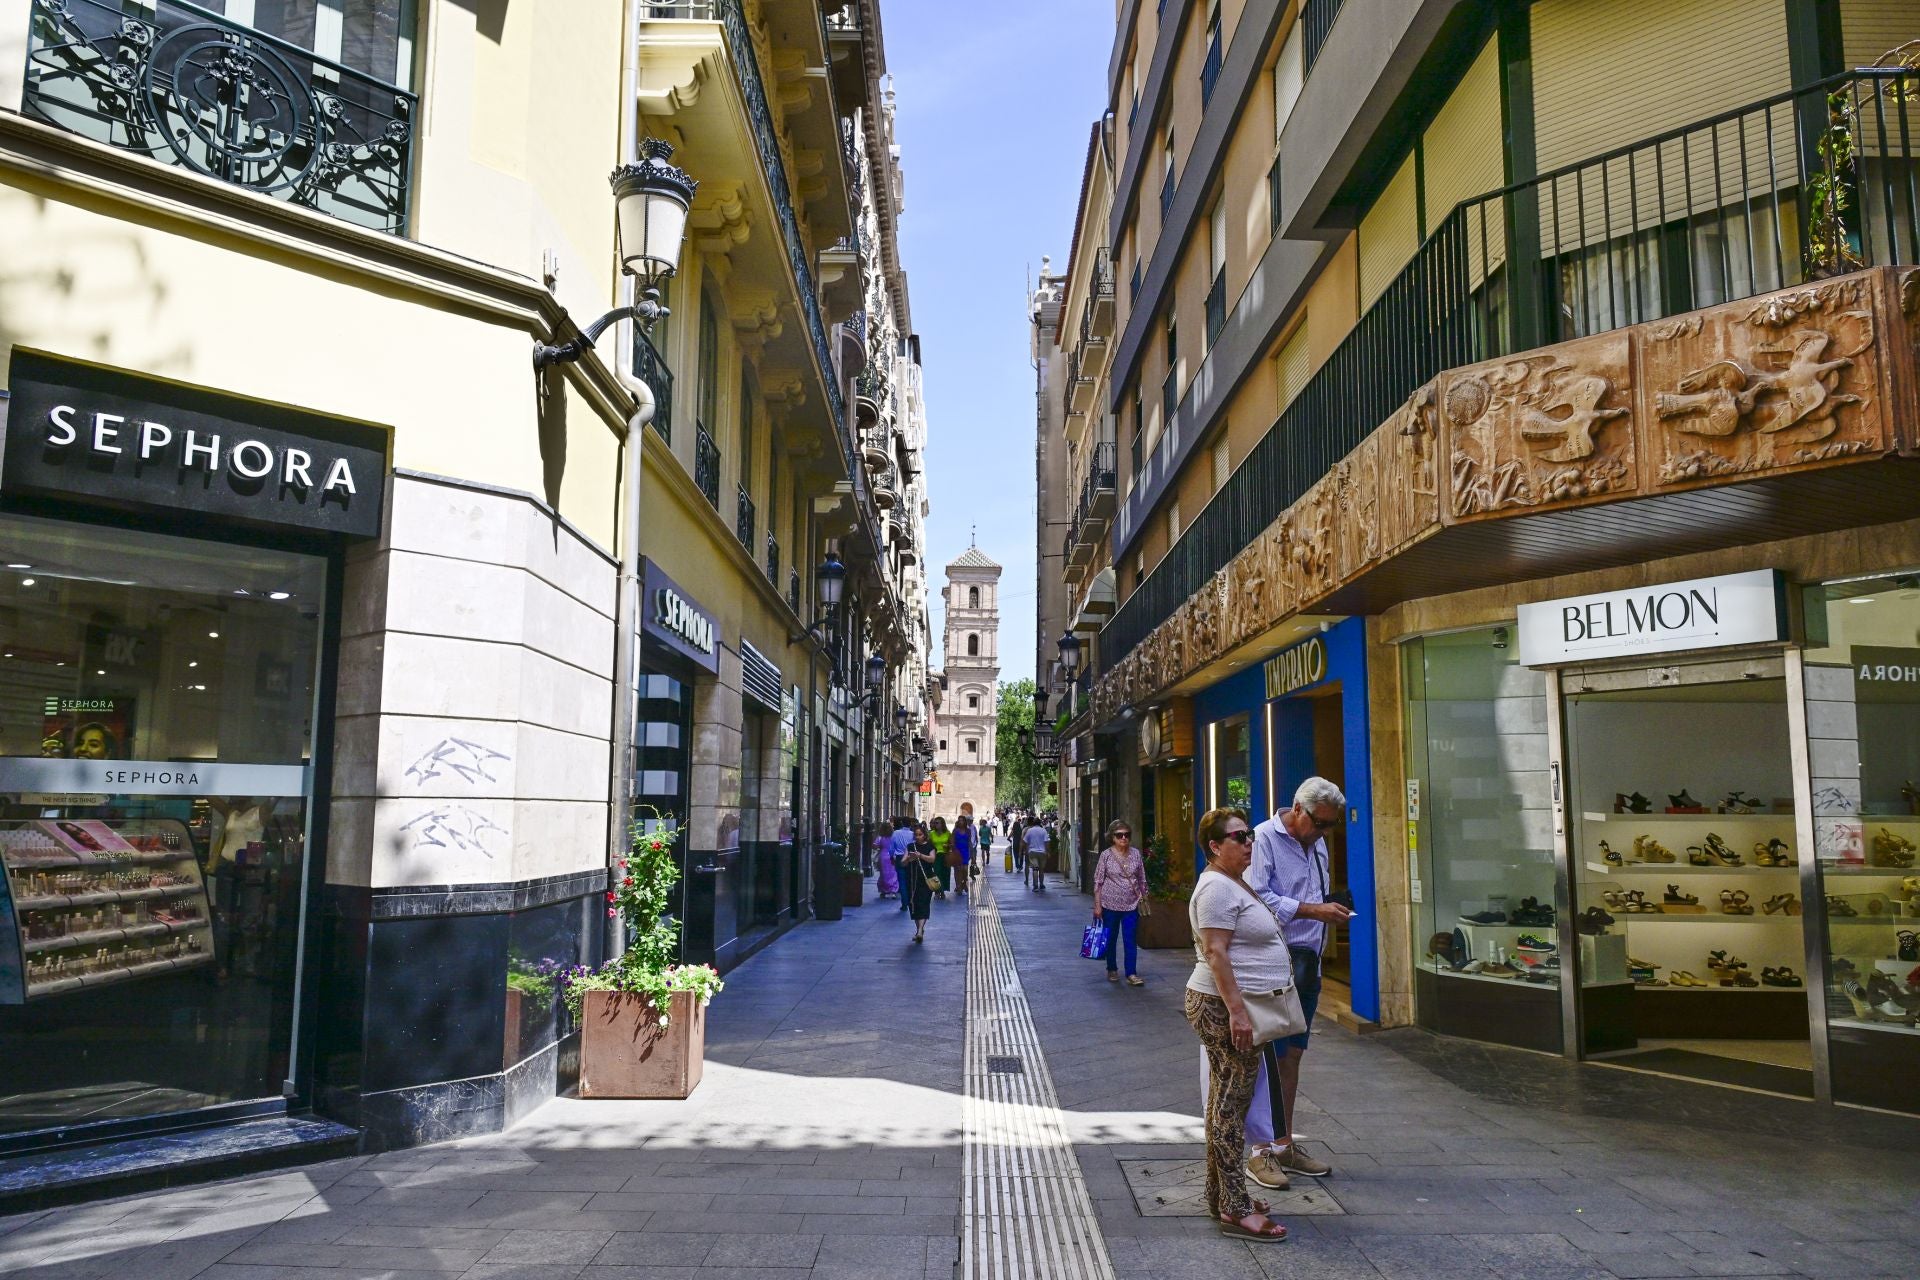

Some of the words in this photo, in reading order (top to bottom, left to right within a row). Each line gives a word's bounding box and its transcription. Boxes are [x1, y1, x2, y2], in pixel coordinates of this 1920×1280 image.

[48, 405, 356, 494] SEPHORA
[664, 588, 714, 655] SEPHORA
[1562, 586, 1719, 643] BELMON
[1263, 637, 1322, 700] TEMPERATO
[61, 700, 114, 708] SEPHORA
[105, 770, 199, 785] SEPHORA
